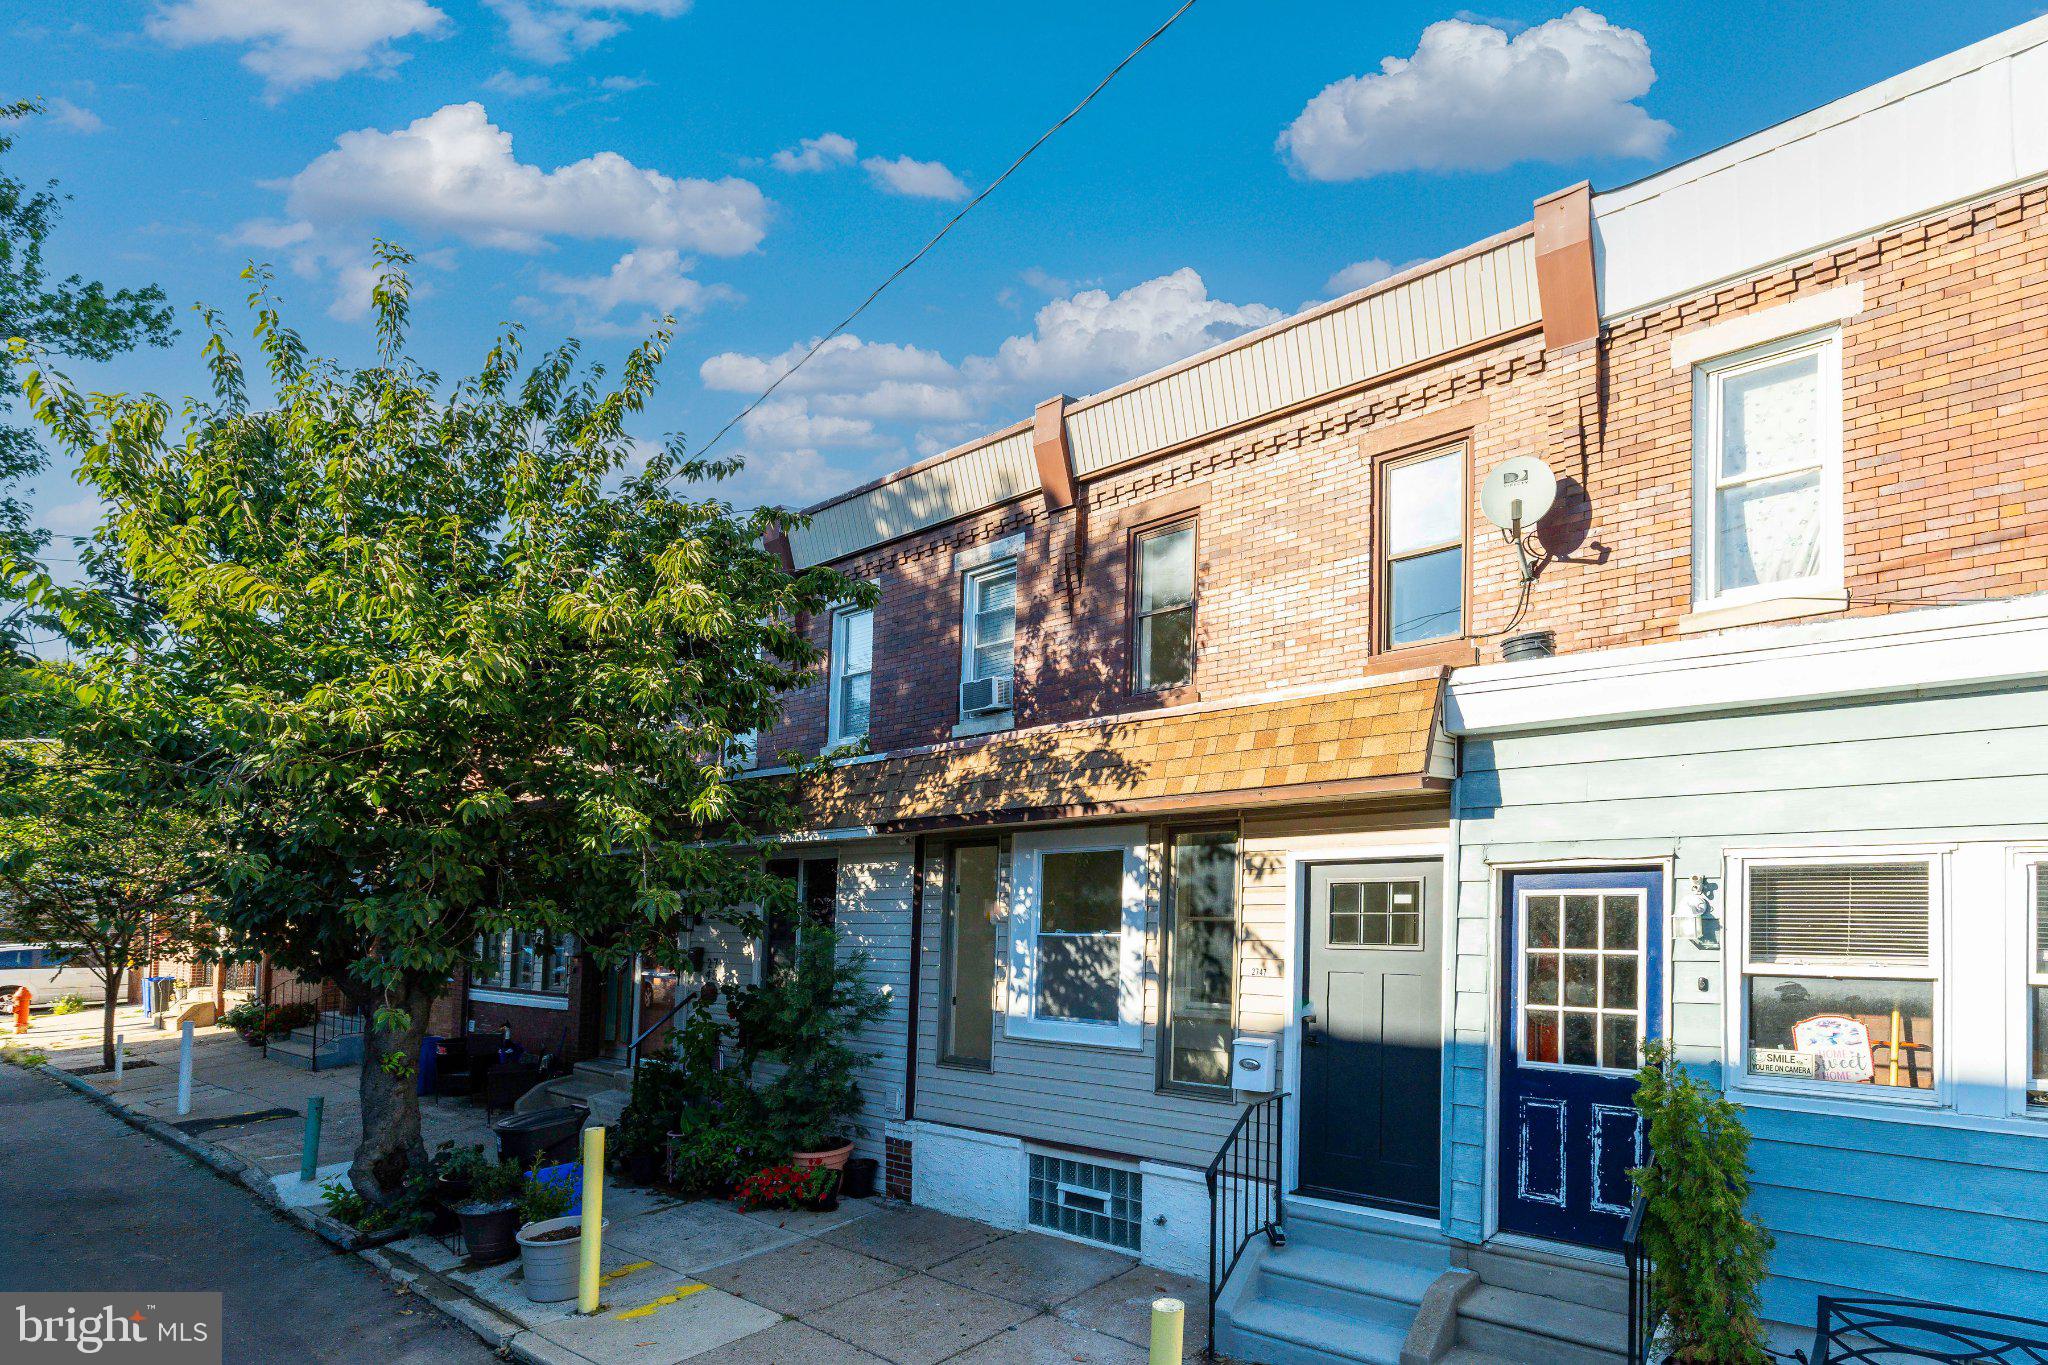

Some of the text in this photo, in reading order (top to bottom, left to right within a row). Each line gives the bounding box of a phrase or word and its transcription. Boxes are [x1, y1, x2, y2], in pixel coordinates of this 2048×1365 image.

[1251, 967, 1267, 976] 2747
[1751, 1063, 1774, 1072] YOURE
[1784, 1065, 1812, 1075] CAMERA
